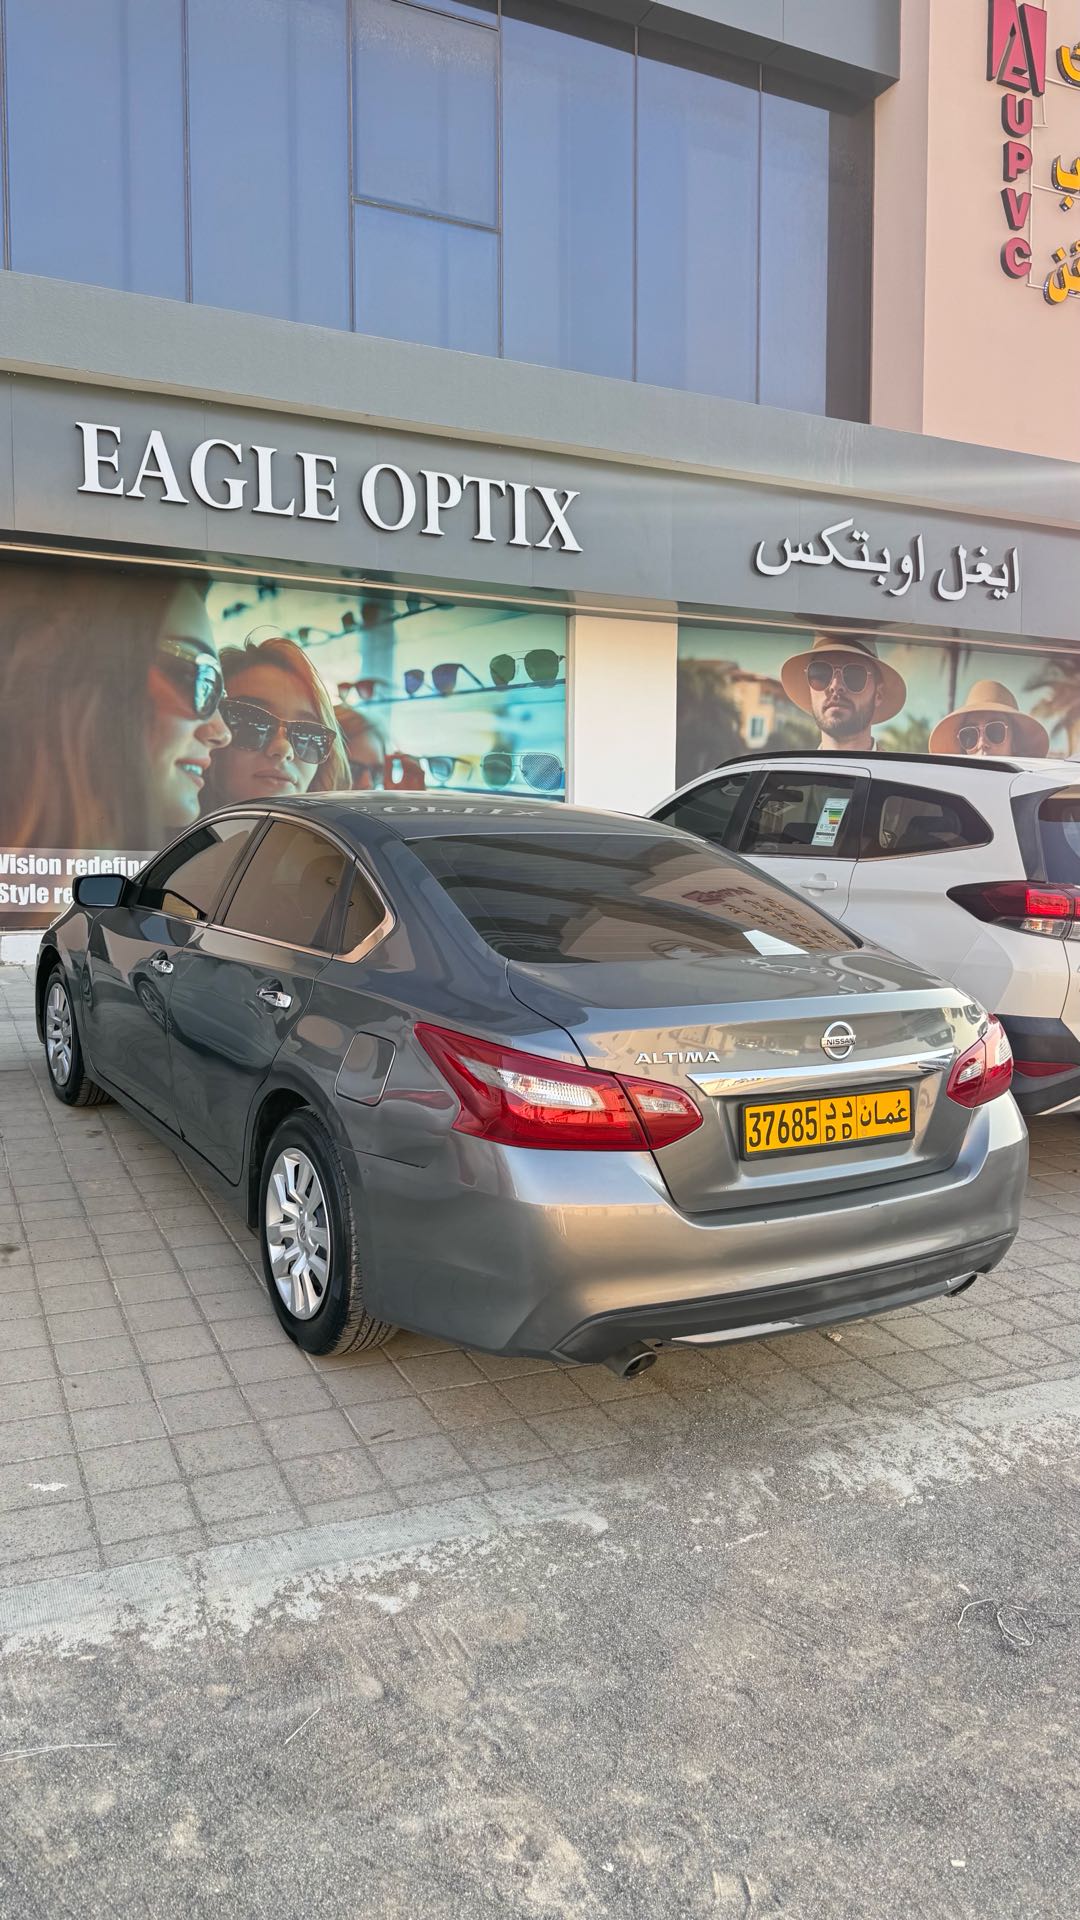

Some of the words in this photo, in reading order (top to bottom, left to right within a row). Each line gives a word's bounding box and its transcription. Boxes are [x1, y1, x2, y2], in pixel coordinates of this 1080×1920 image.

[75, 421, 340, 522] EAGLE
[361, 463, 584, 552] OPTIX
[753, 518, 925, 596] اوبتكس
[0, 854, 62, 875] Vision
[0, 883, 50, 905] Style
[826, 1036, 856, 1046] NISSAN
[634, 1051, 721, 1065] ALTIMA
[748, 1106, 818, 1148] 37685
